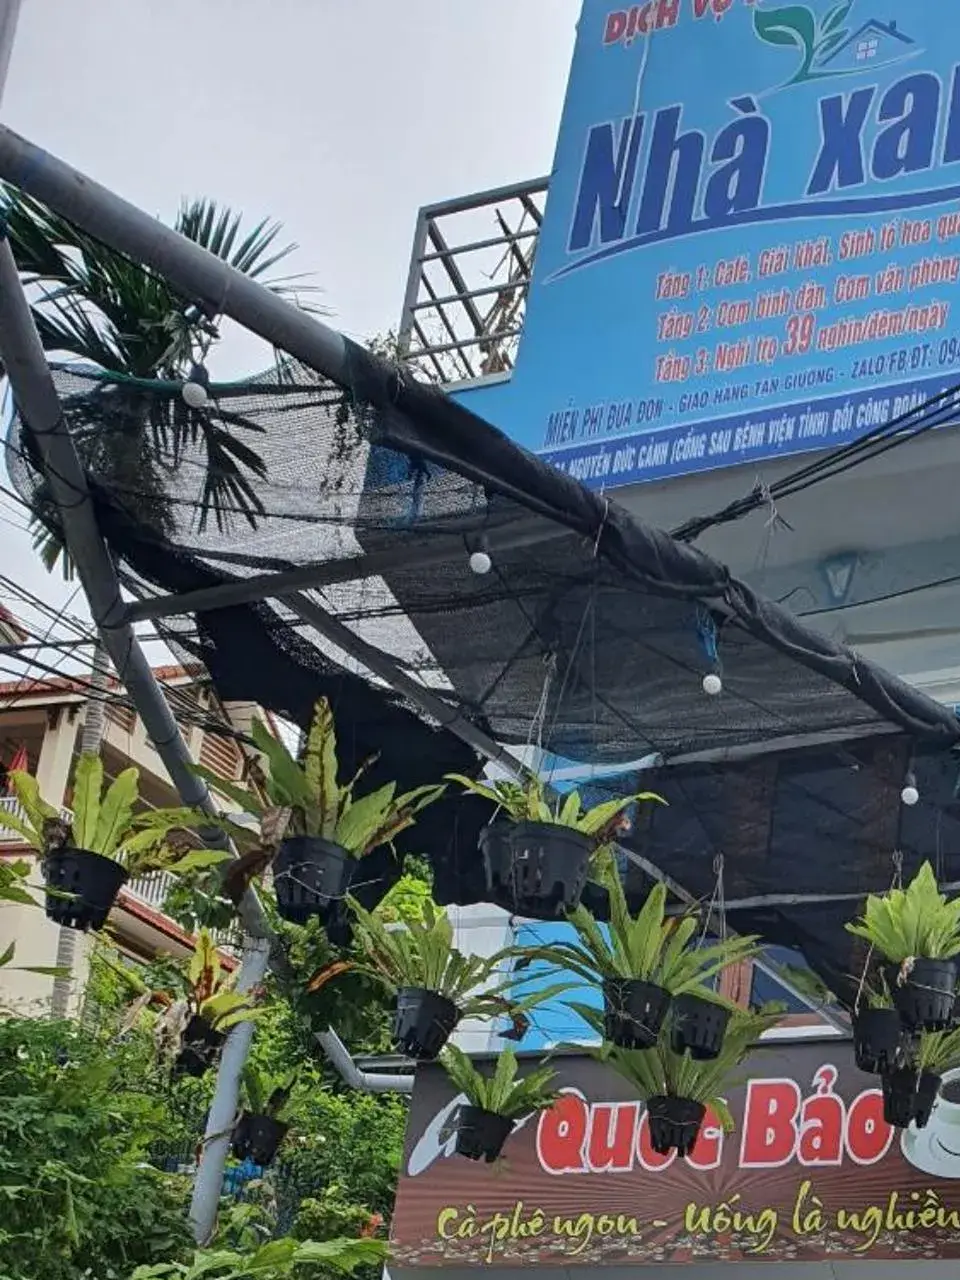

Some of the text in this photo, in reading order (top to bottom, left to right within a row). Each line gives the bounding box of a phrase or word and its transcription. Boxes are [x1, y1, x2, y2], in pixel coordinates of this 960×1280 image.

[603, 0, 681, 48] DỊCH
[566, 95, 771, 252] Nhà
[838, 227, 875, 262] Sinh
[879, 217, 898, 252] tố
[901, 218, 931, 246] hoa
[875, 261, 905, 295] văn
[782, 312, 816, 356] 39
[679, 388, 709, 413] GIAO
[709, 427, 732, 455] SAU
[734, 420, 766, 454] BỆNH
[769, 413, 796, 448] VIỆN
[857, 397, 890, 428] CÔNG
[738, 1064, 895, 1168] Bảo
[437, 1204, 480, 1240] Cà
[482, 1201, 546, 1264] phê
[553, 1214, 640, 1256] ngon
[792, 1180, 826, 1234] là
